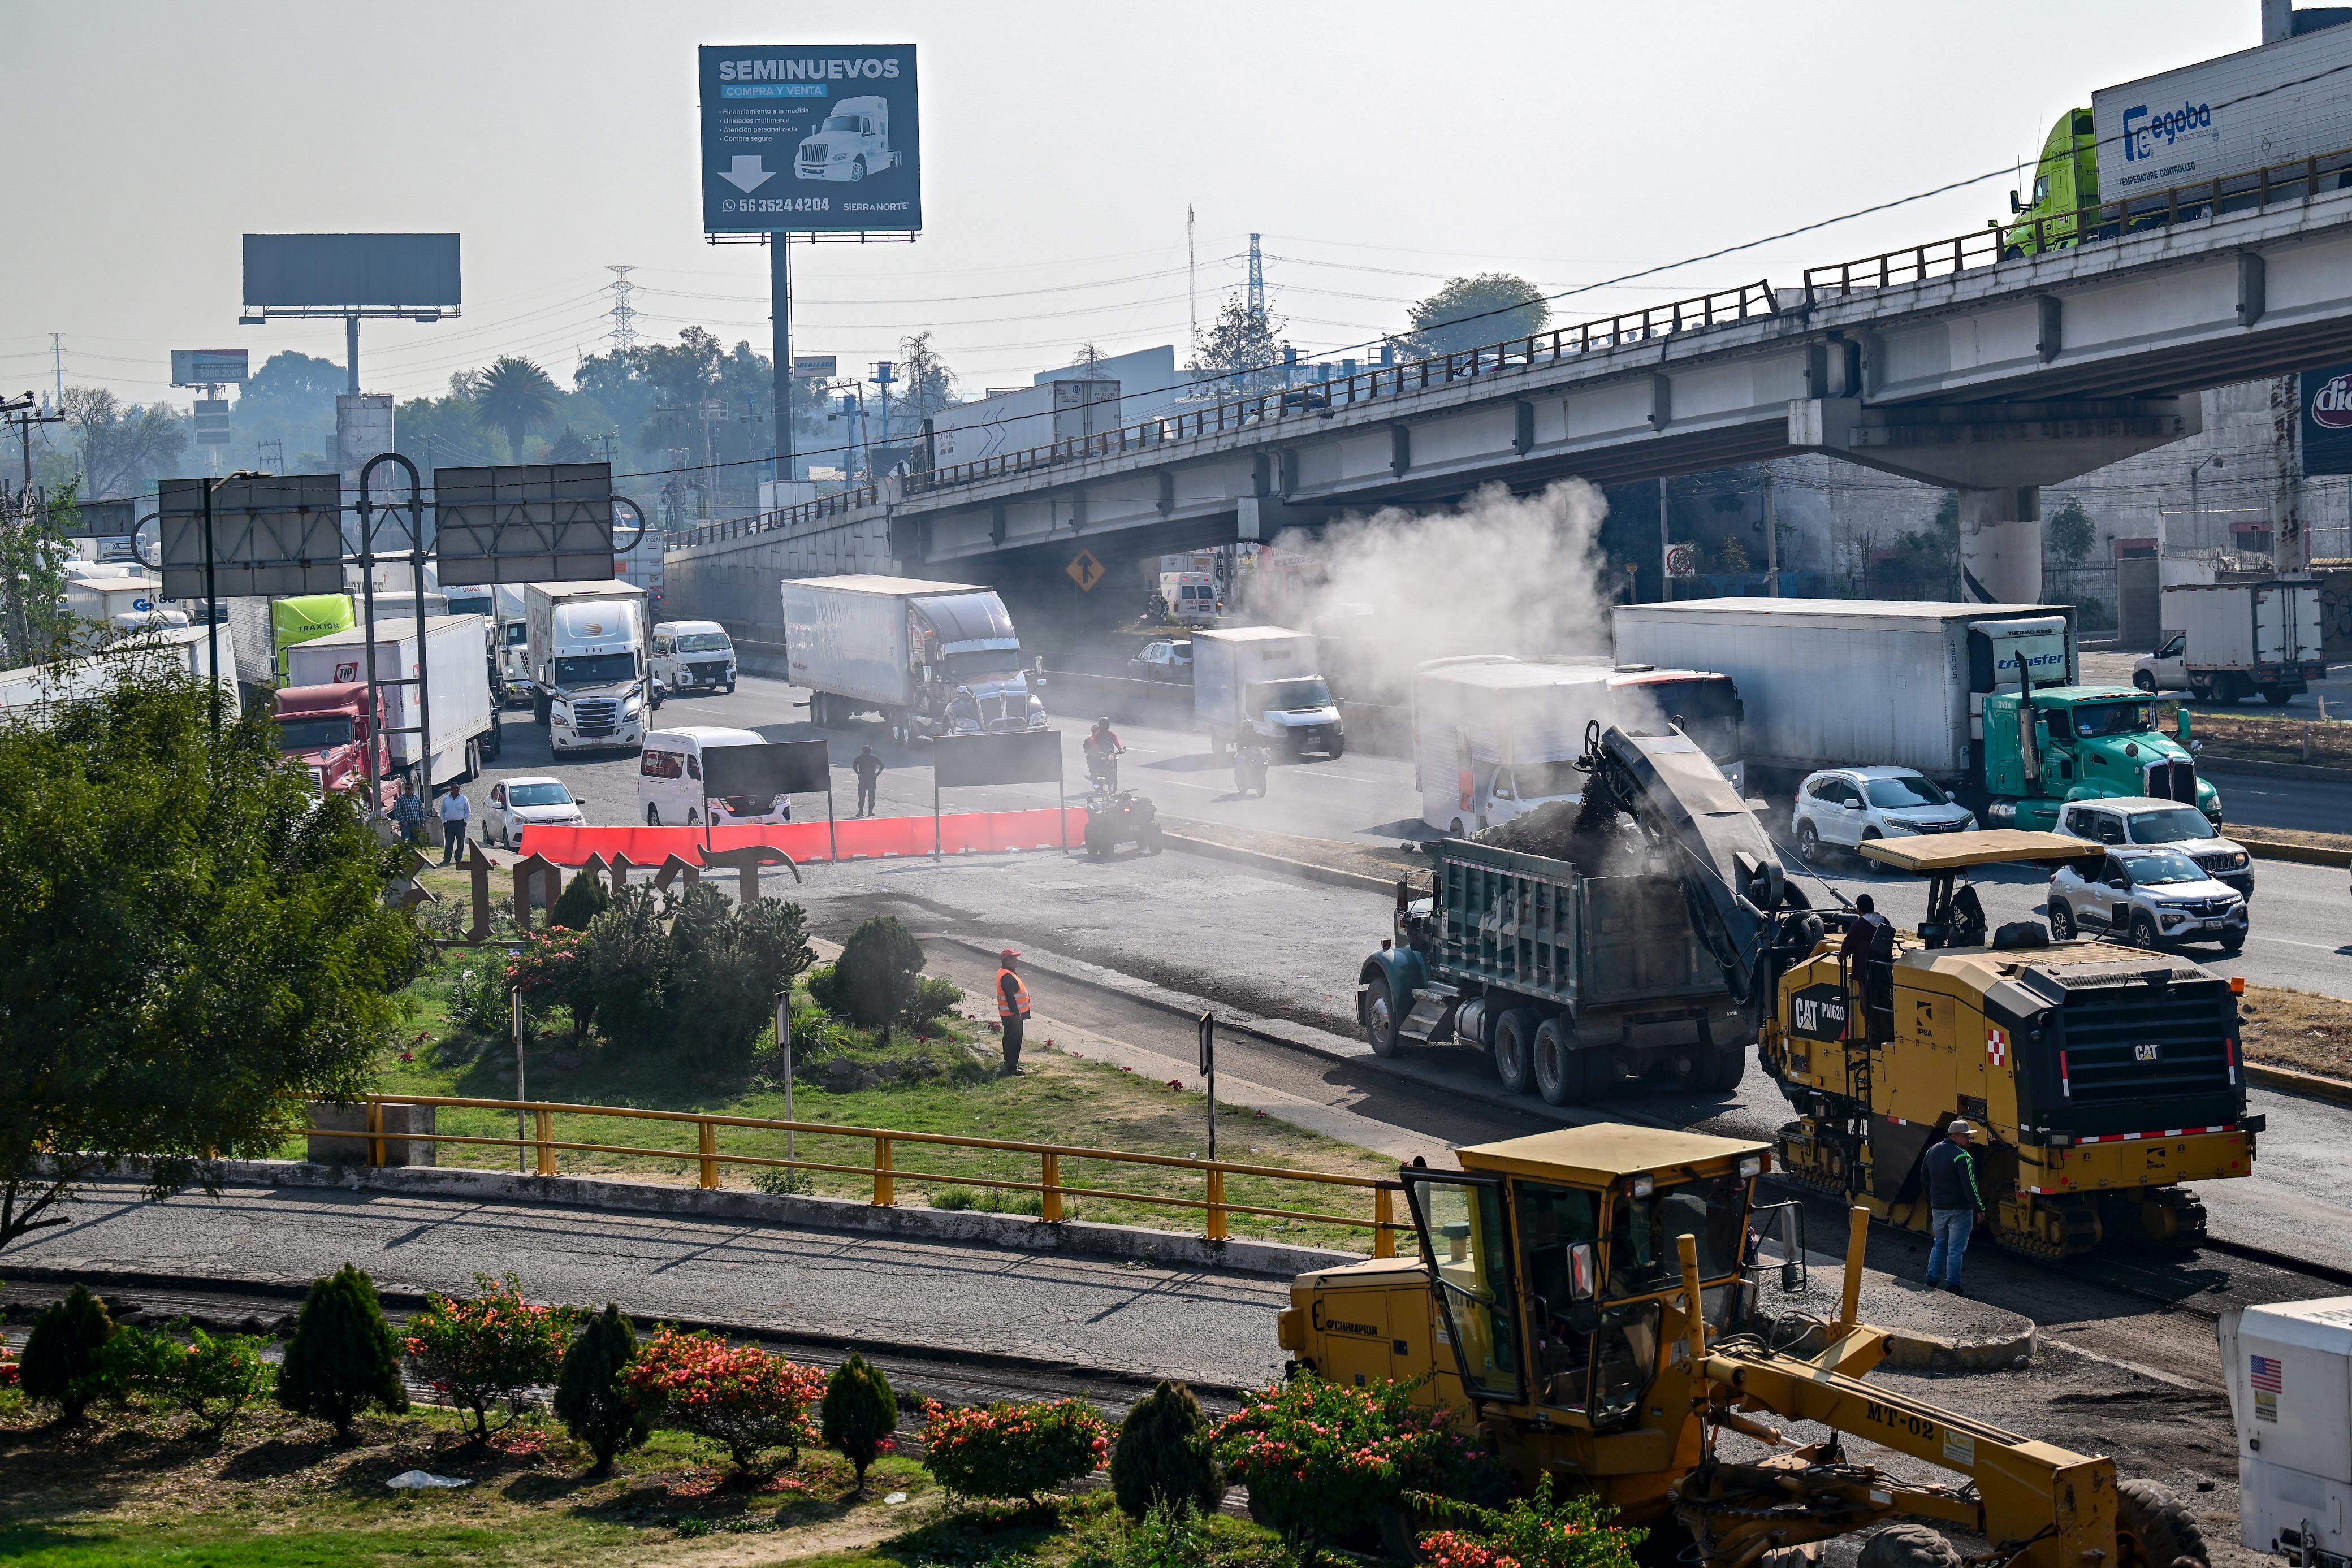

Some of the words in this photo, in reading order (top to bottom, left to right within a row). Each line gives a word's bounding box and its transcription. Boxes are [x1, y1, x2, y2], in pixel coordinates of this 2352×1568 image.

[719, 58, 900, 80] SEMINUEVOS
[726, 87, 773, 96] COMPRA
[776, 86, 784, 95] Y
[786, 86, 822, 95] VENTA
[2160, 162, 2195, 177] CONTROLLED
[740, 199, 756, 212] 56
[759, 199, 792, 212] 3524
[795, 198, 830, 211] 4204
[200, 369, 241, 378] 5980.2009
[937, 431, 957, 441] PATRIOT
[299, 622, 339, 633] TRAXIÓN
[1998, 653, 2063, 669] transfer
[339, 668, 352, 679] TIP
[1796, 998, 1818, 1032] CAT
[1822, 1002, 1844, 1021] PM620
[1917, 1027, 1932, 1037] IPSA
[2135, 1044, 2158, 1060] CAT
[1334, 1320, 1377, 1335] CHAMPION
[1866, 1401, 1934, 1441] MT-02
